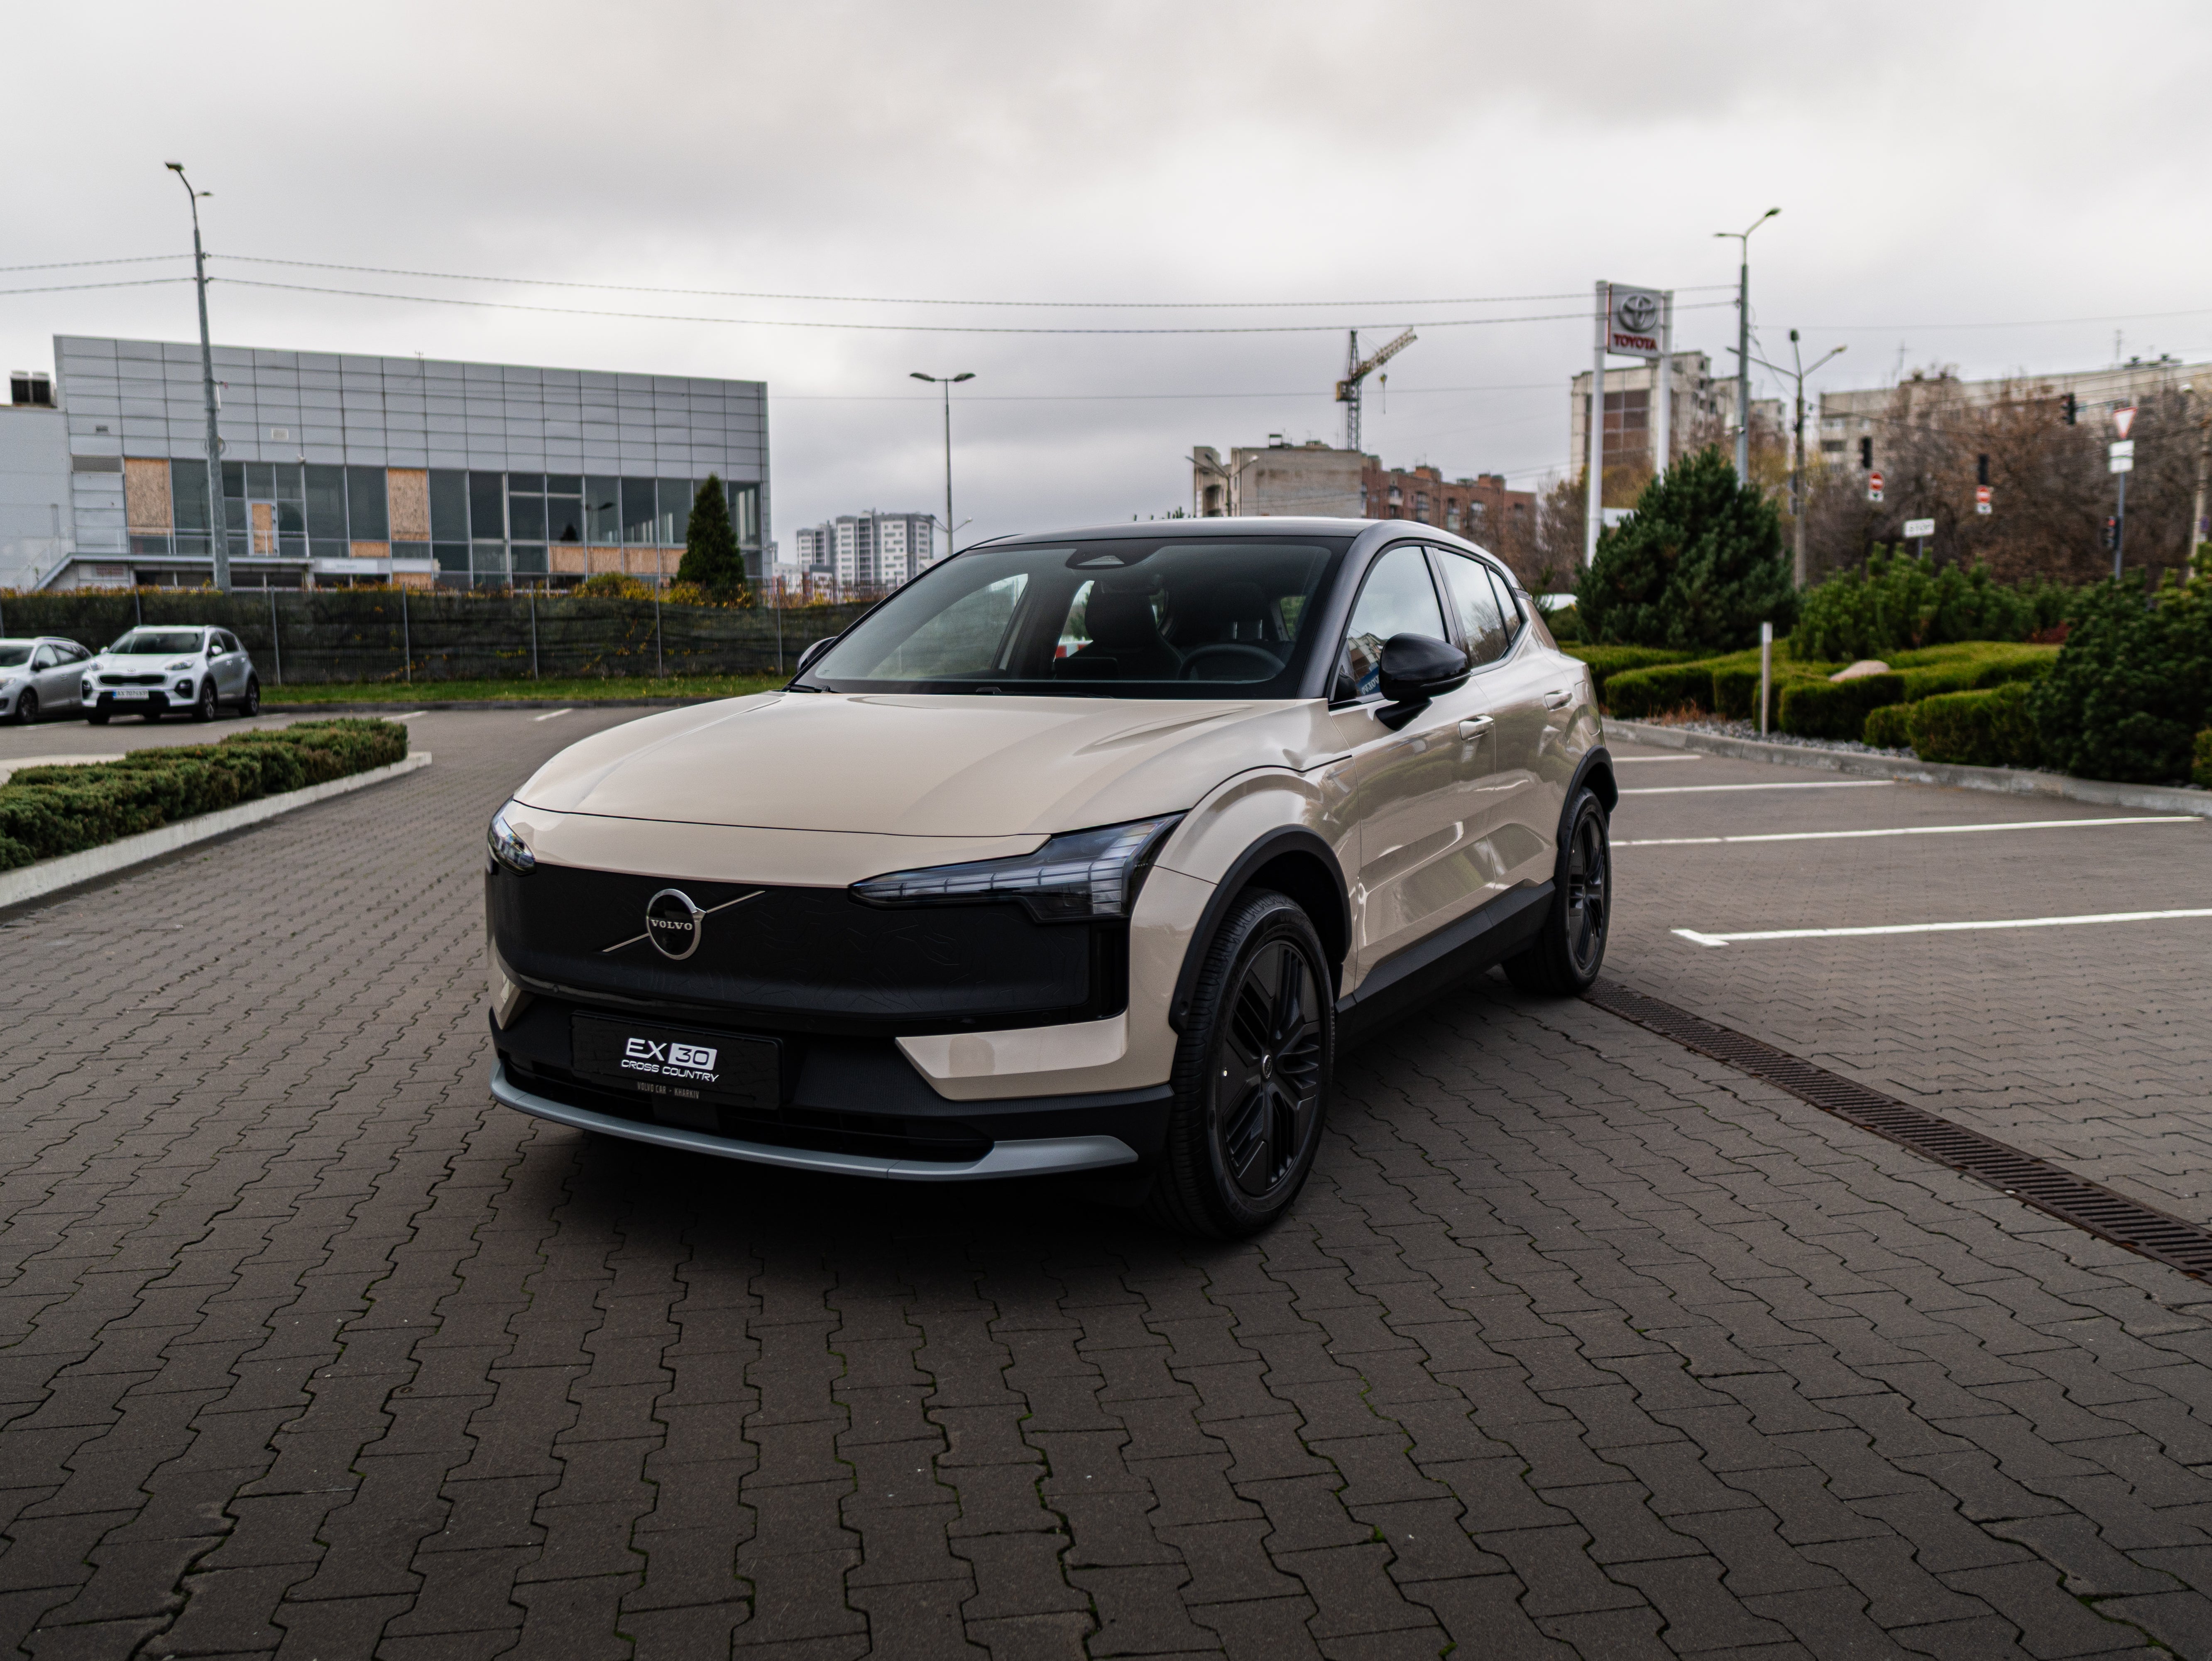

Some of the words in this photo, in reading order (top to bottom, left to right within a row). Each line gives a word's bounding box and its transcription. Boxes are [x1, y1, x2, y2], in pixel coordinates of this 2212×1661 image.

[1614, 333, 1658, 350] TOYOTA
[651, 919, 693, 930] VOLVO
[626, 1038, 667, 1061] EX
[675, 1047, 710, 1066] 30
[622, 1059, 660, 1072] CROSS
[662, 1066, 719, 1082] COUNTRY
[637, 1082, 654, 1092] VOLVO
[656, 1085, 666, 1094] CAR
[674, 1088, 700, 1099] KHARKIV
